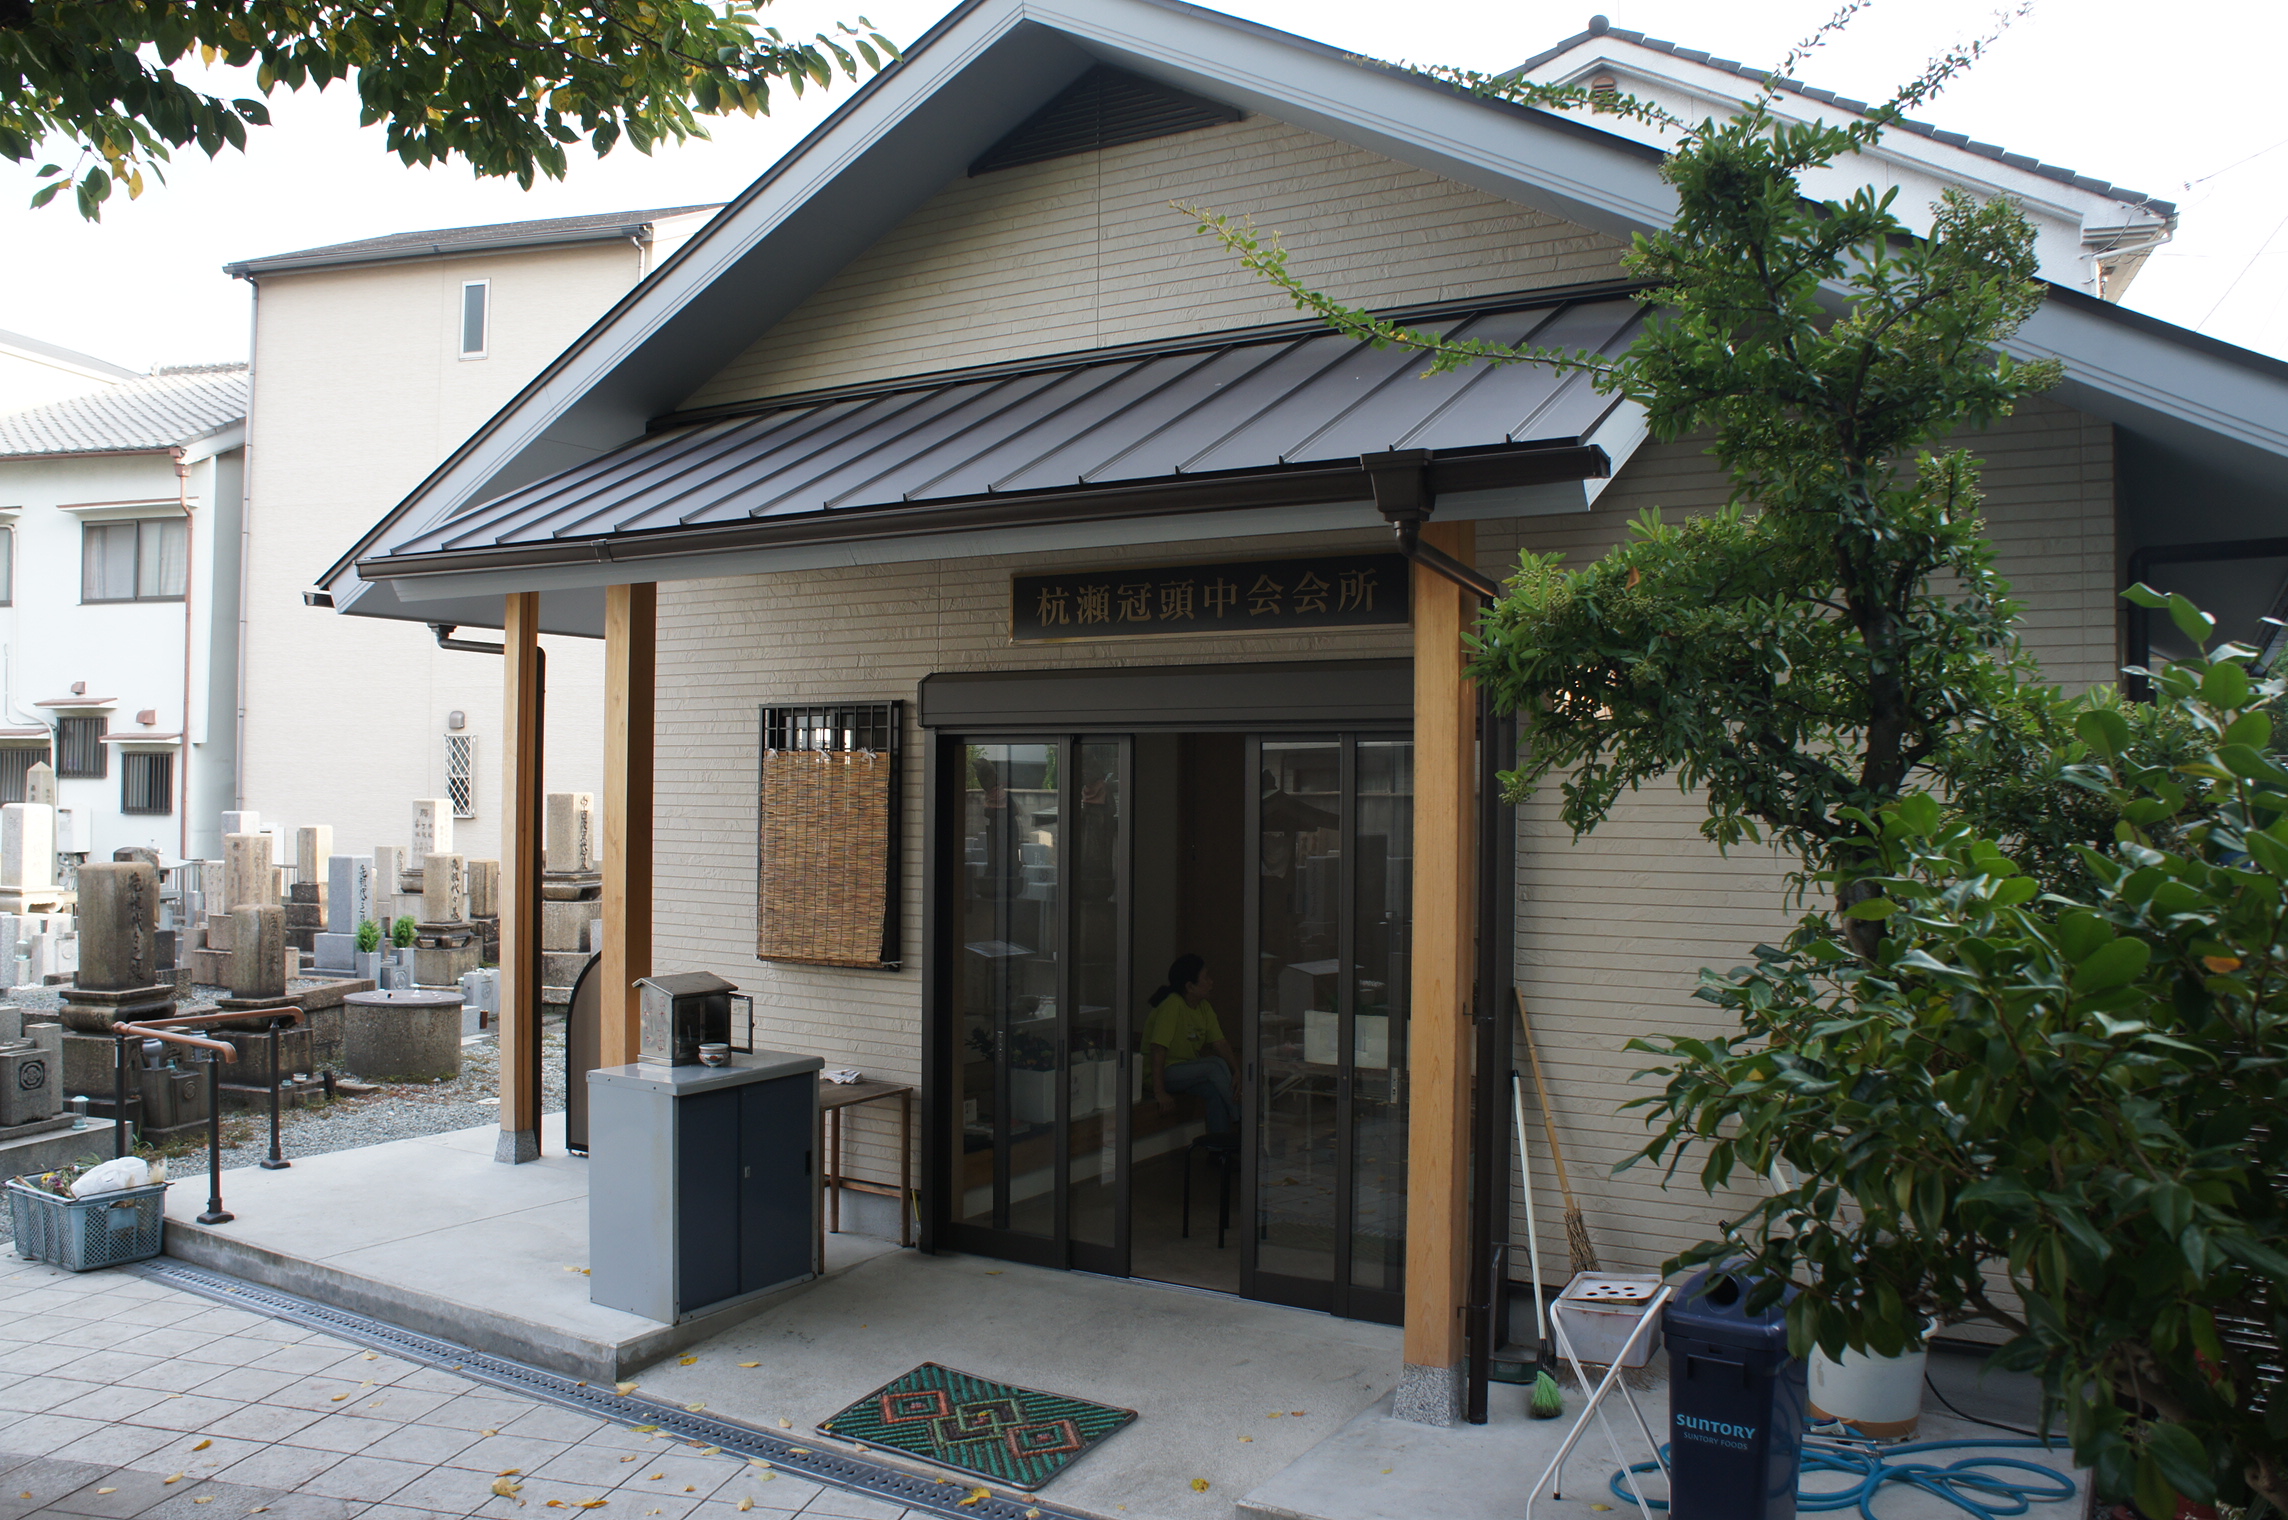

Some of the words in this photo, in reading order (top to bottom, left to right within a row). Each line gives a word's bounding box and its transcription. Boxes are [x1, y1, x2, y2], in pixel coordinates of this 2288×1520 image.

[1036, 567, 1379, 627] 杭瀬冠頭中会会所
[1676, 1413, 1756, 1440] SUNTORY
[1683, 1431, 1719, 1445] SUNTORY
[1720, 1439, 1748, 1450] FOODS
